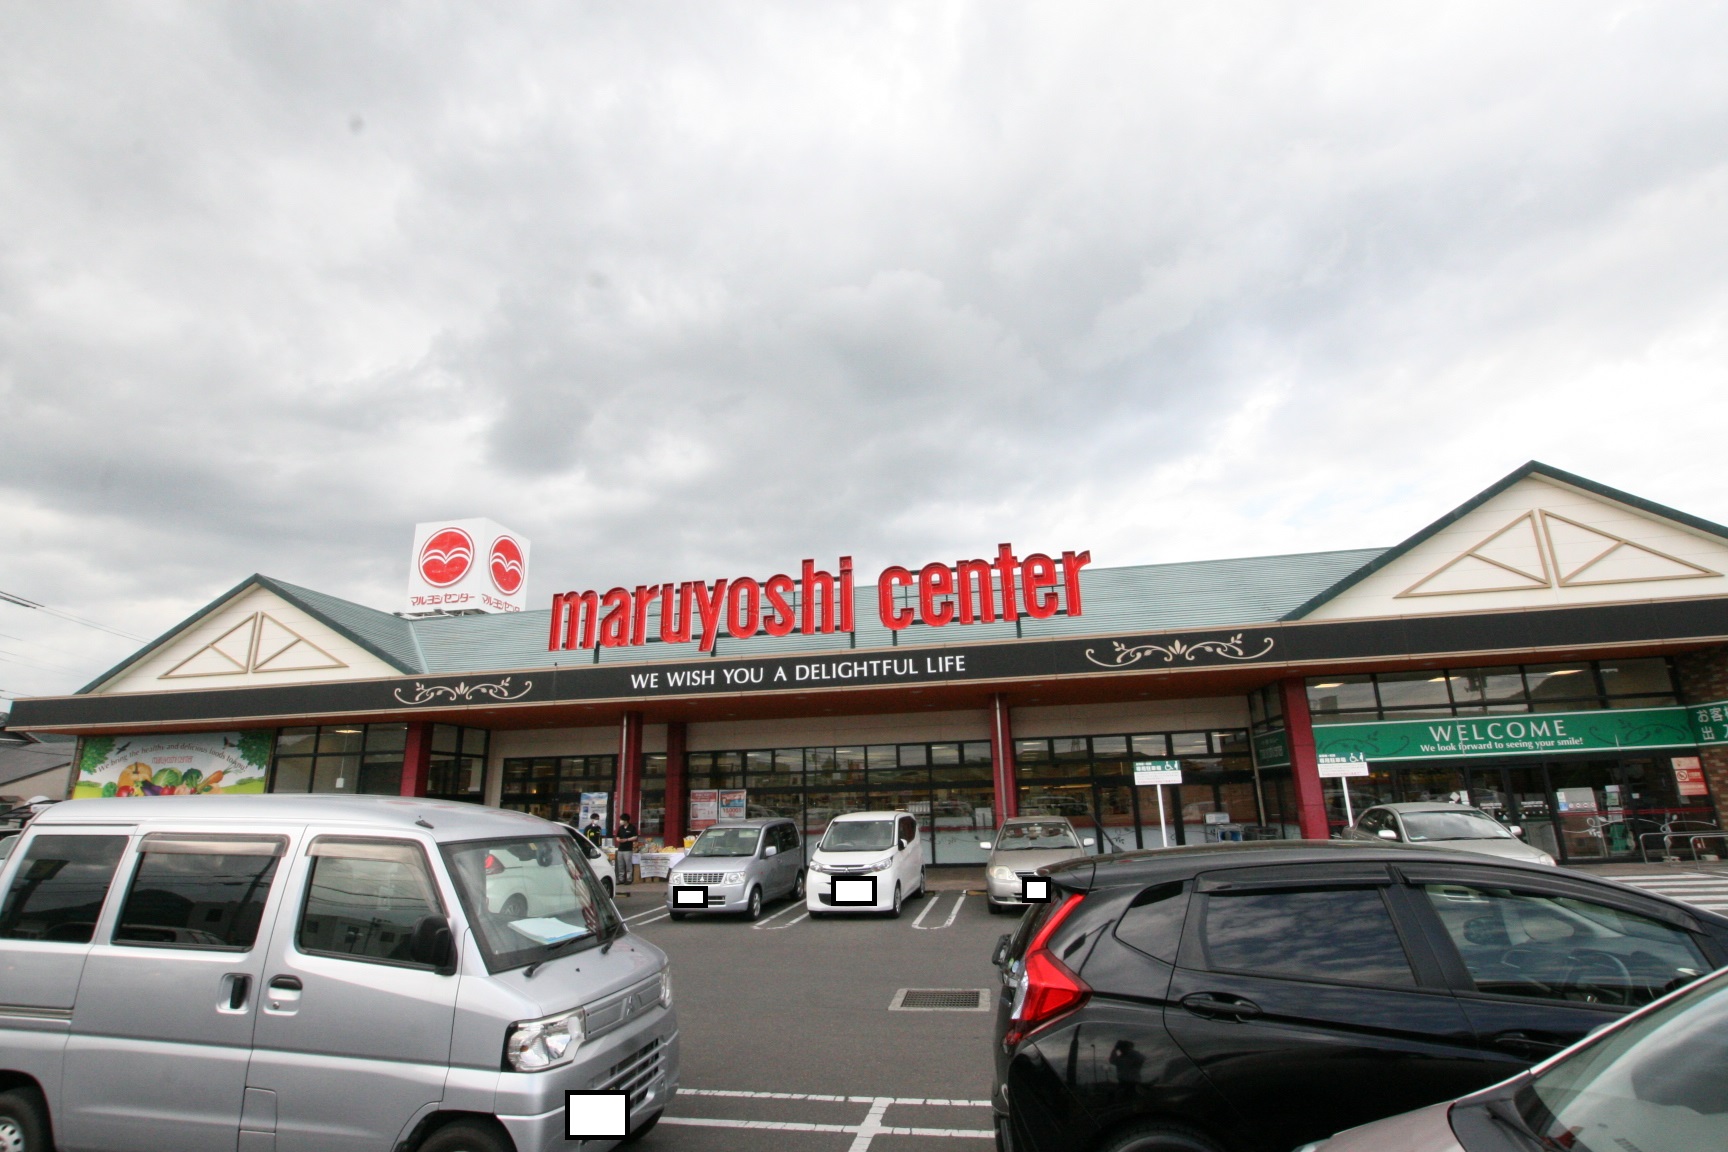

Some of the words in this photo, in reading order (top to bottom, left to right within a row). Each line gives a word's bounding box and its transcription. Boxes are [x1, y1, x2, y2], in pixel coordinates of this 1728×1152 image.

[410, 593, 475, 606] マルヨシセンター
[548, 556, 855, 652] maruyoshi
[878, 542, 1091, 631] center
[630, 673, 659, 689] WE
[666, 669, 715, 687] WISH
[722, 667, 764, 684] YOU
[773, 666, 788, 682] A
[795, 658, 918, 680] DELIGHTFUL
[926, 655, 966, 674] LIFE
[1428, 719, 1567, 742] WELCOME
[1420, 744, 1436, 752] We
[1437, 743, 1457, 751] look
[1458, 741, 1493, 751] forward
[1494, 741, 1504, 749] to
[1505, 740, 1534, 750] seeing
[1534, 740, 1555, 750] your
[1557, 737, 1584, 746] smile!
[98, 764, 110, 772] We
[110, 755, 128, 766] bring
[129, 750, 140, 758] the
